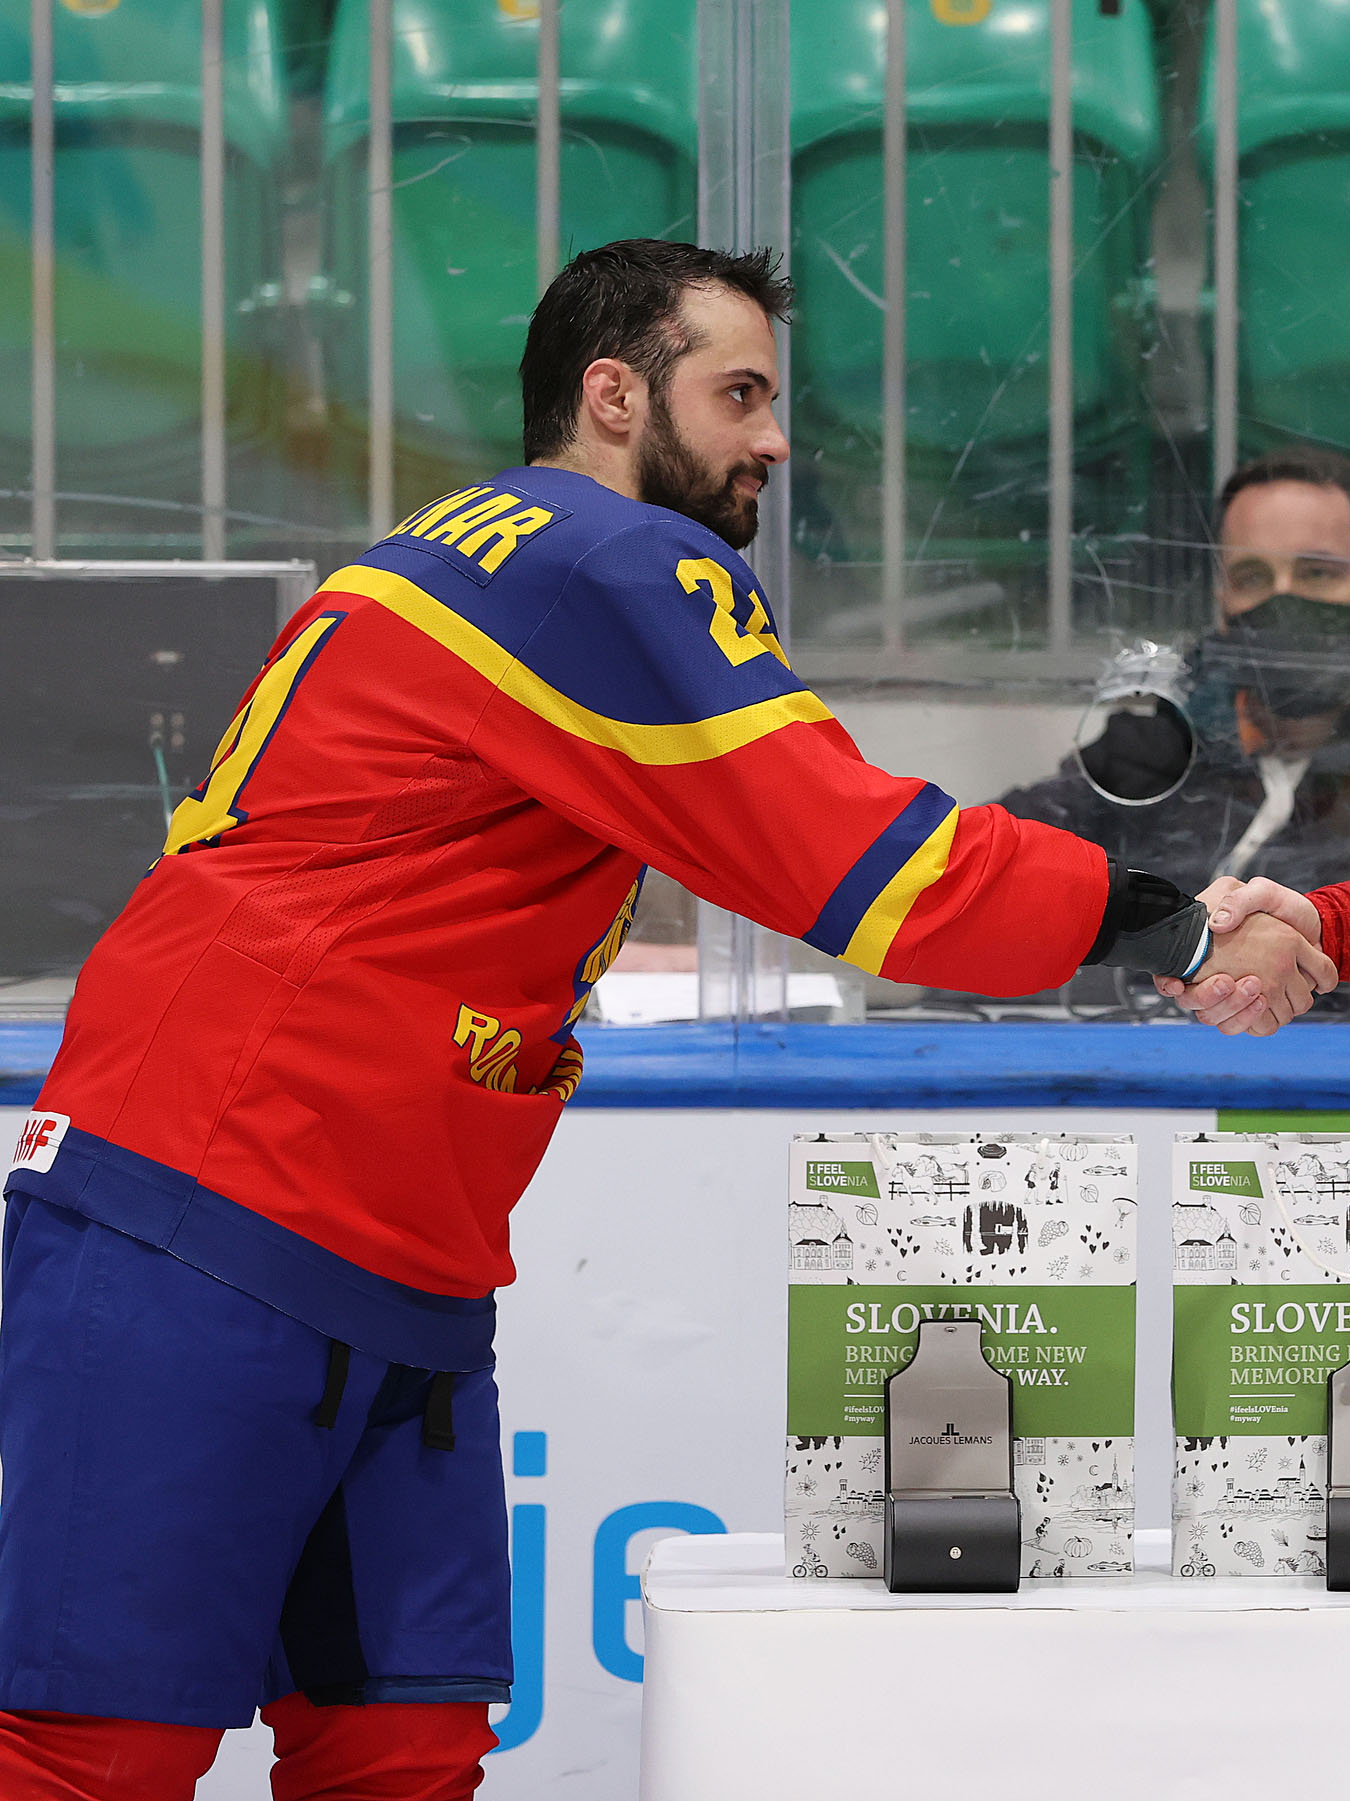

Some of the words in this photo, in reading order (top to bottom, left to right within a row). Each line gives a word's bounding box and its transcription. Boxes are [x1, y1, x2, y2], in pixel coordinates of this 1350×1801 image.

[385, 486, 555, 575] NAR
[808, 1163, 814, 1174] I
[816, 1163, 846, 1174] FEEL
[1191, 1163, 1198, 1174] I
[1200, 1163, 1228, 1174] FEEL
[808, 1175, 869, 1187] SLOVENIA
[1191, 1175, 1252, 1187] SLOVENIA
[844, 1345, 914, 1364] BRING
[982, 1346, 1030, 1364] OME
[1035, 1346, 1087, 1364] NEW
[1229, 1344, 1341, 1364] BRINGING
[1016, 1368, 1069, 1387] WAY.
[1229, 1366, 1337, 1386] MEMORIE
[844, 1405, 885, 1414] #ifeelsLOV
[1230, 1405, 1289, 1414] #ifeelsLOVEnia
[844, 1415, 875, 1424] #myway
[1230, 1415, 1262, 1424] #myway
[909, 1436, 951, 1445] JACQUES
[954, 1436, 993, 1445] LEMANS
